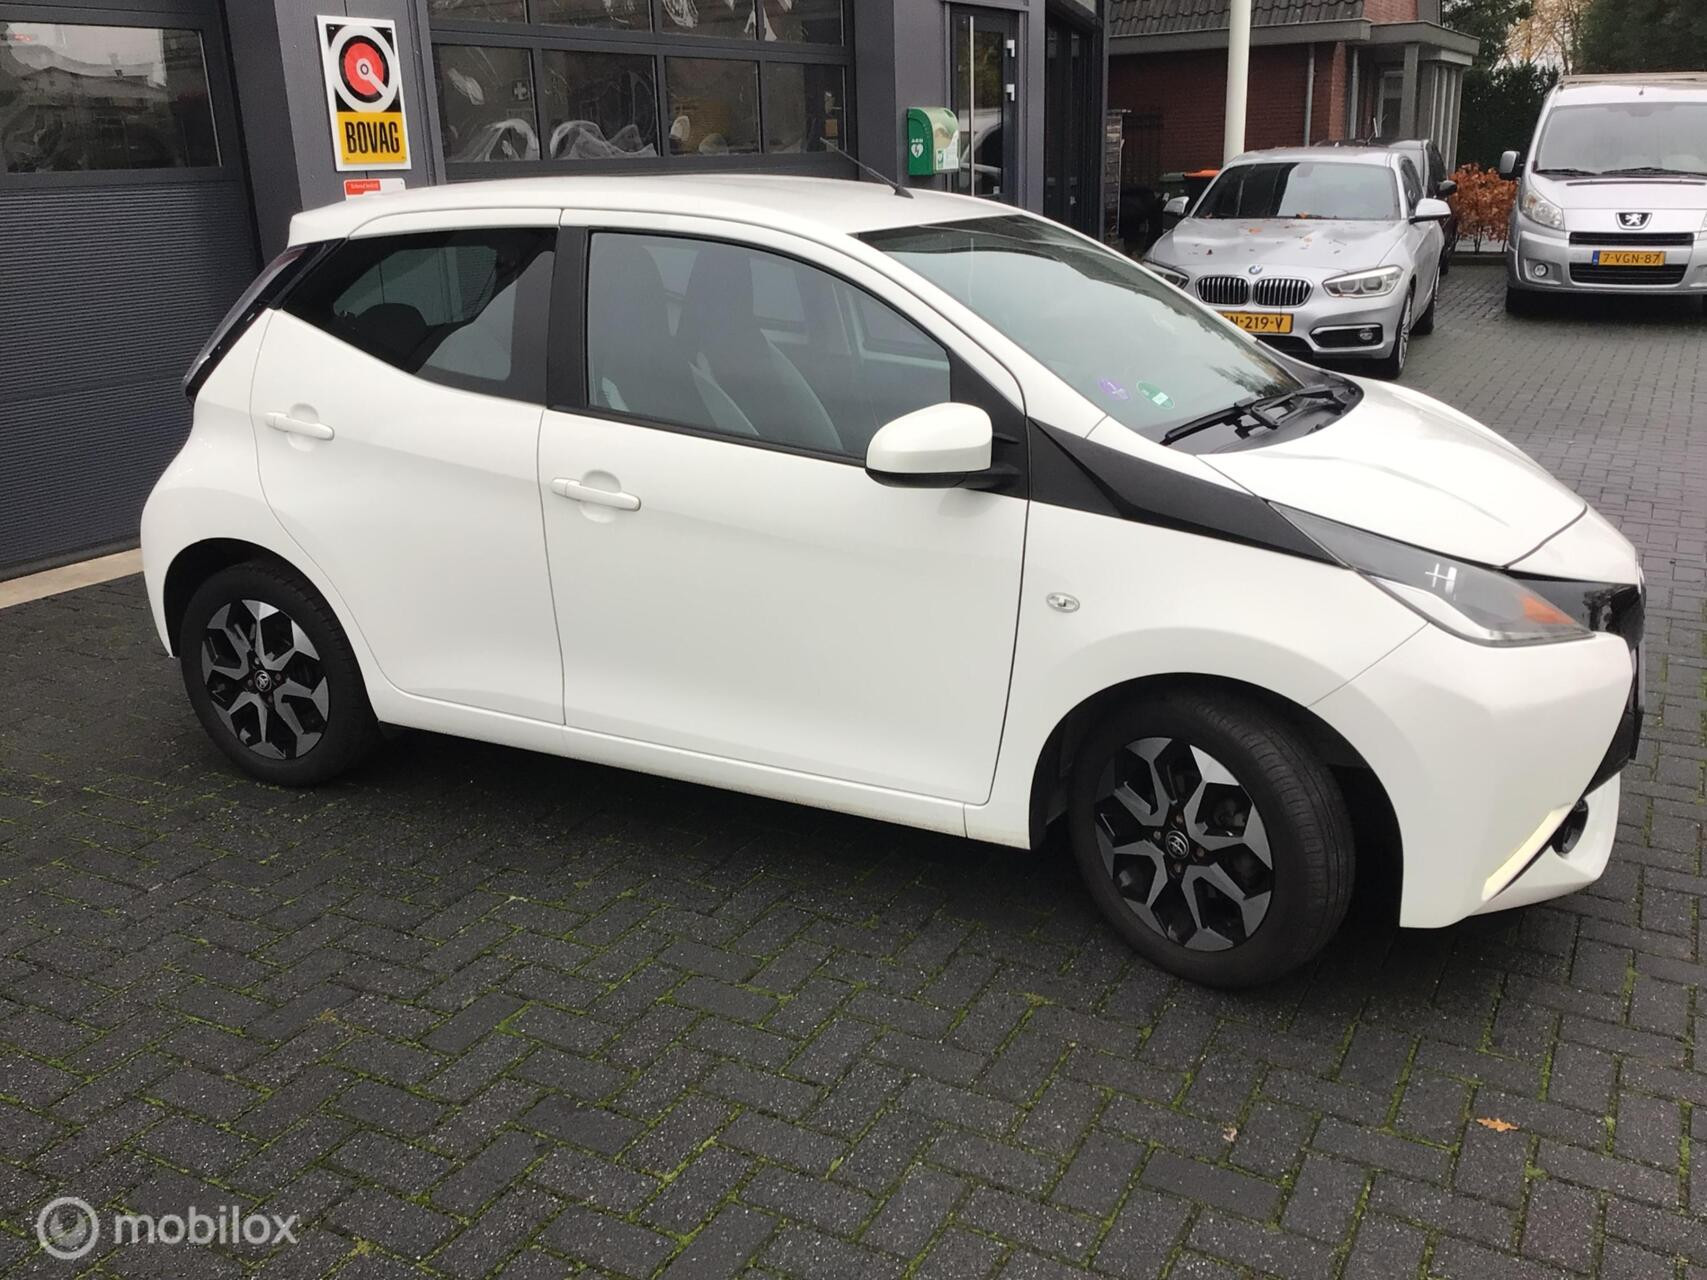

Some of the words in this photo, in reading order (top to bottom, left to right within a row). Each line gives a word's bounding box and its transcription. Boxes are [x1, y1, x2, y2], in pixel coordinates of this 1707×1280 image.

[344, 121, 400, 154] BOVAG
[1602, 253, 1661, 264] 7-VGN-87
[1224, 315, 1285, 331] N-219-V
